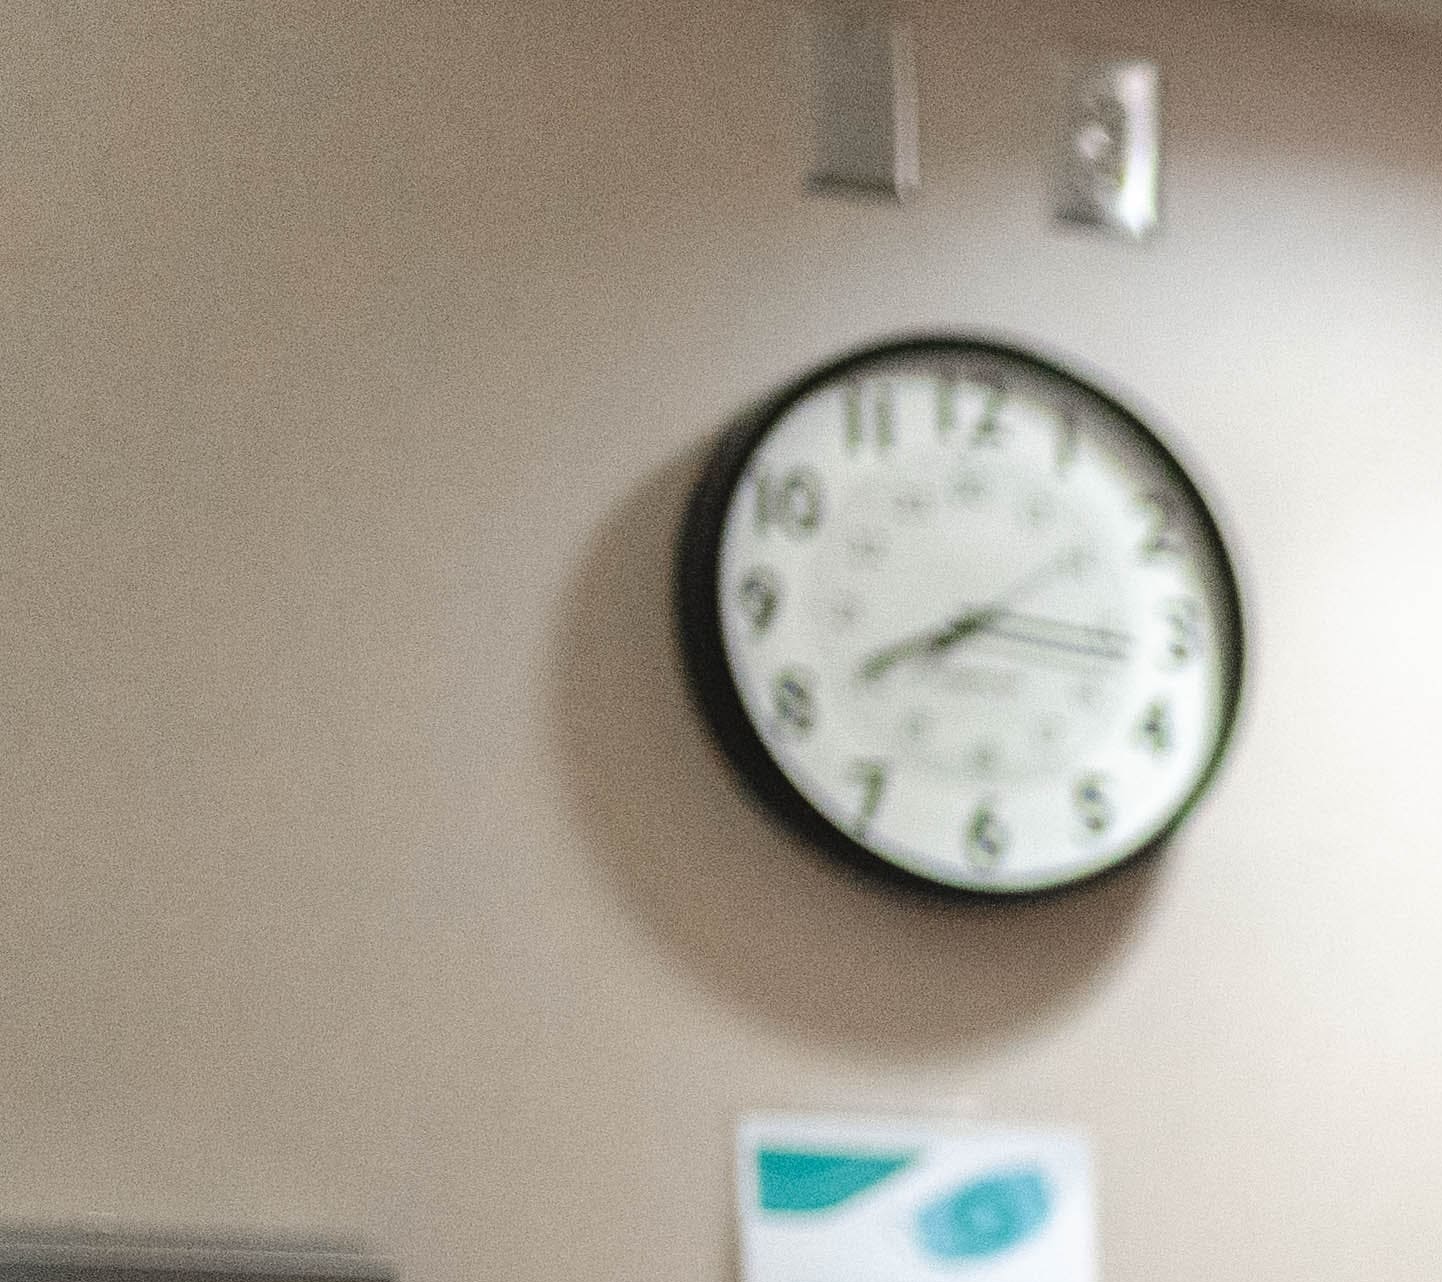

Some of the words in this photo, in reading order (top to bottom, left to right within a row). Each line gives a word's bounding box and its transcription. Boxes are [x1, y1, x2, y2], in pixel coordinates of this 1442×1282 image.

[841, 378, 898, 458] 11
[934, 363, 1008, 449] 12
[753, 464, 829, 541] 10
[1135, 482, 1183, 563] 2
[739, 564, 785, 642] 9
[1167, 596, 1201, 670] 3
[771, 662, 818, 736] 8
[1134, 696, 1174, 759] 4
[848, 754, 892, 840] 7
[962, 794, 1011, 864] 6
[1070, 769, 1113, 837] 5
